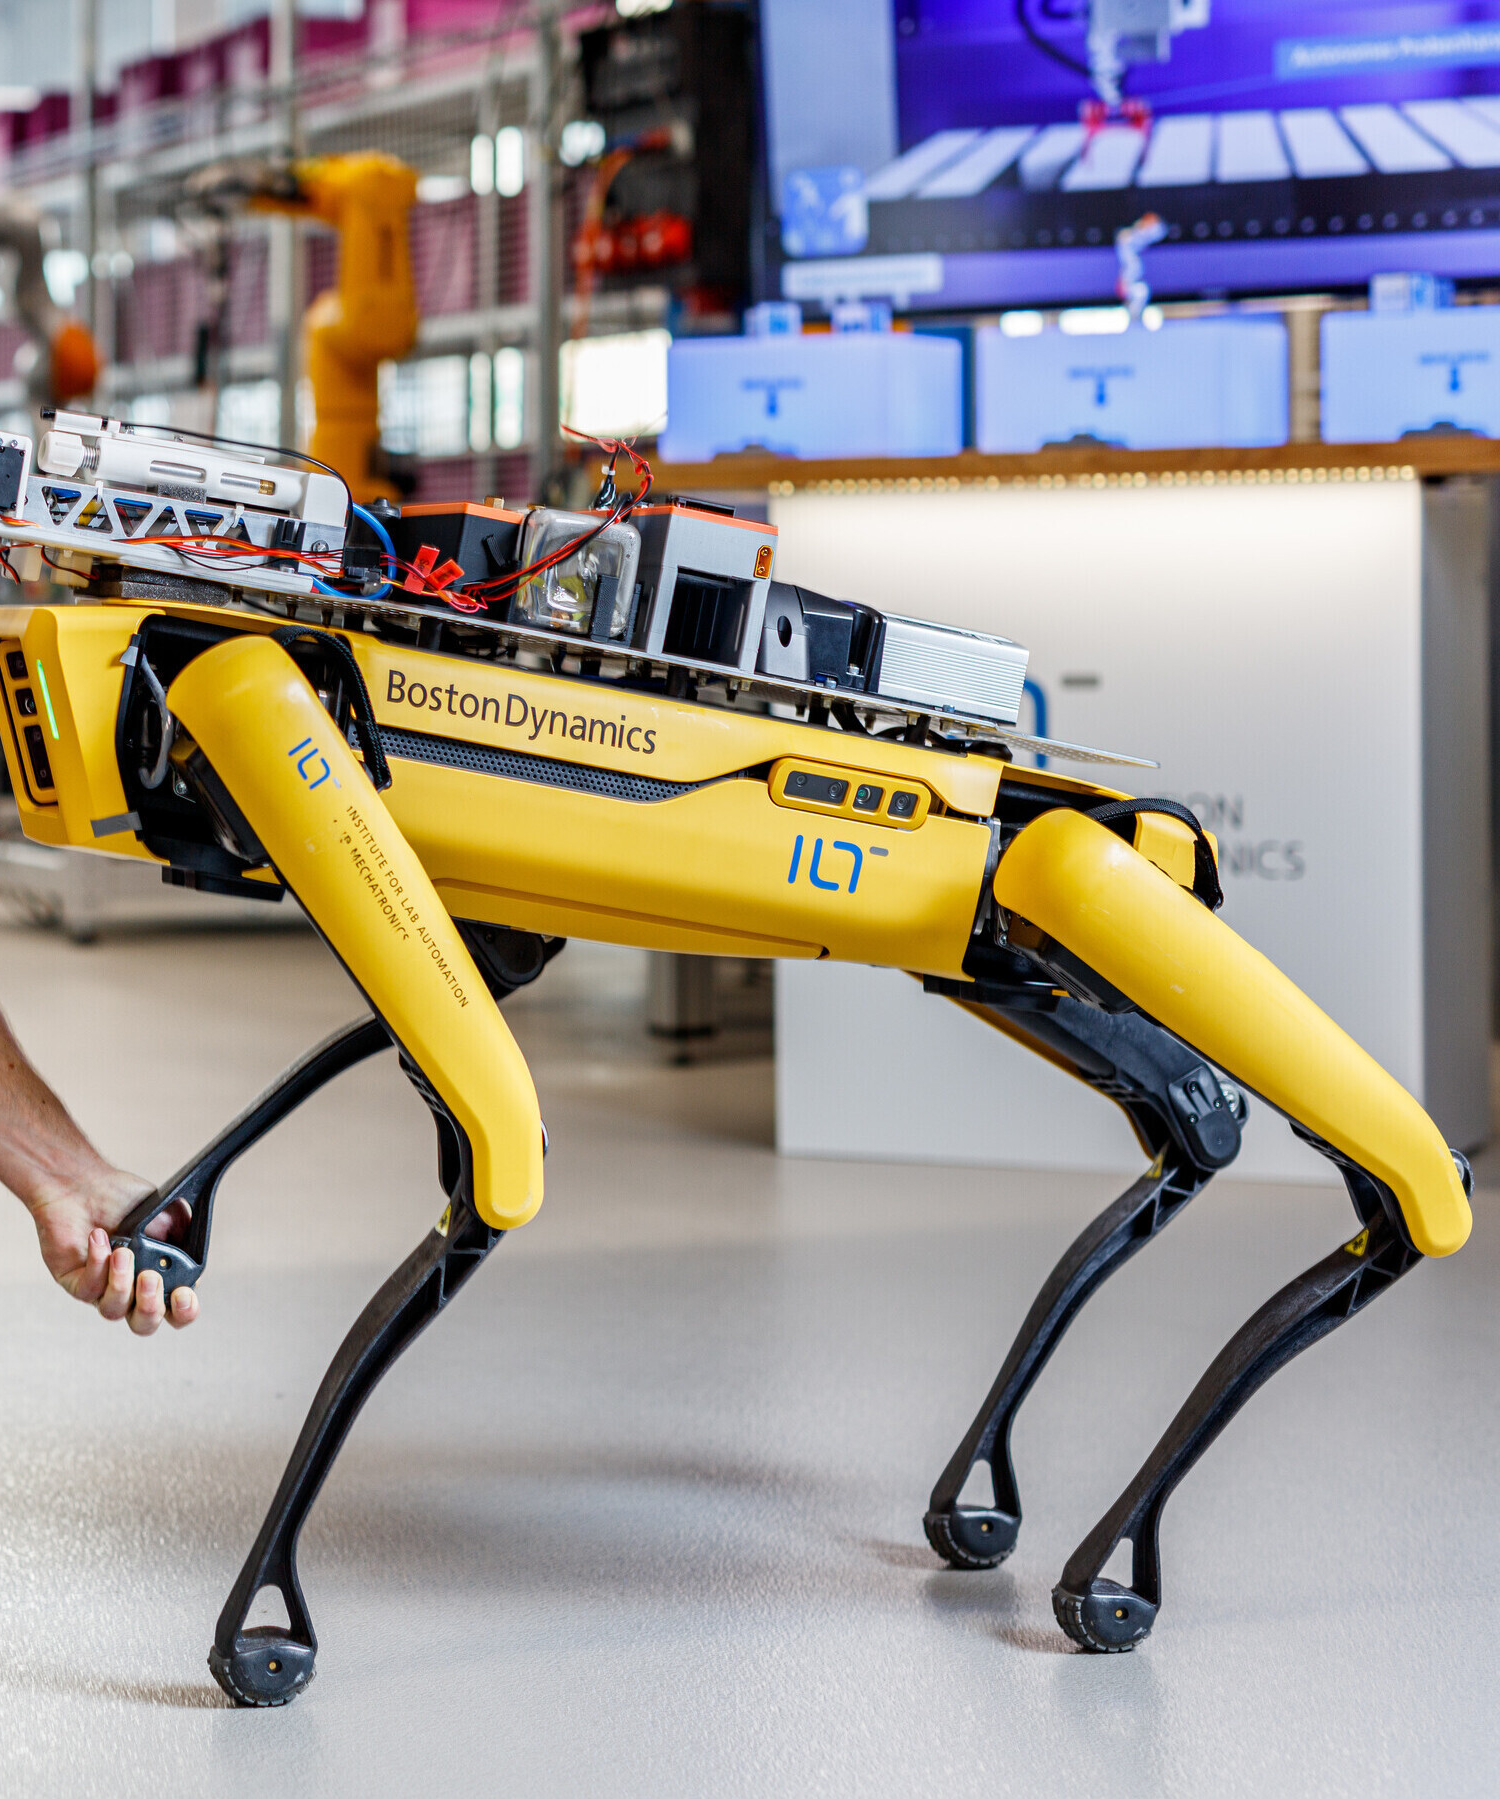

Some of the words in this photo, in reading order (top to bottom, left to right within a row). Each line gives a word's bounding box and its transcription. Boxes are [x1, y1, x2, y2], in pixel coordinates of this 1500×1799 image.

[346, 805, 389, 870] INSTITUTE
[384, 870, 404, 897] FOR
[400, 897, 420, 923] LAB
[416, 926, 470, 1008] AUTOMATION
